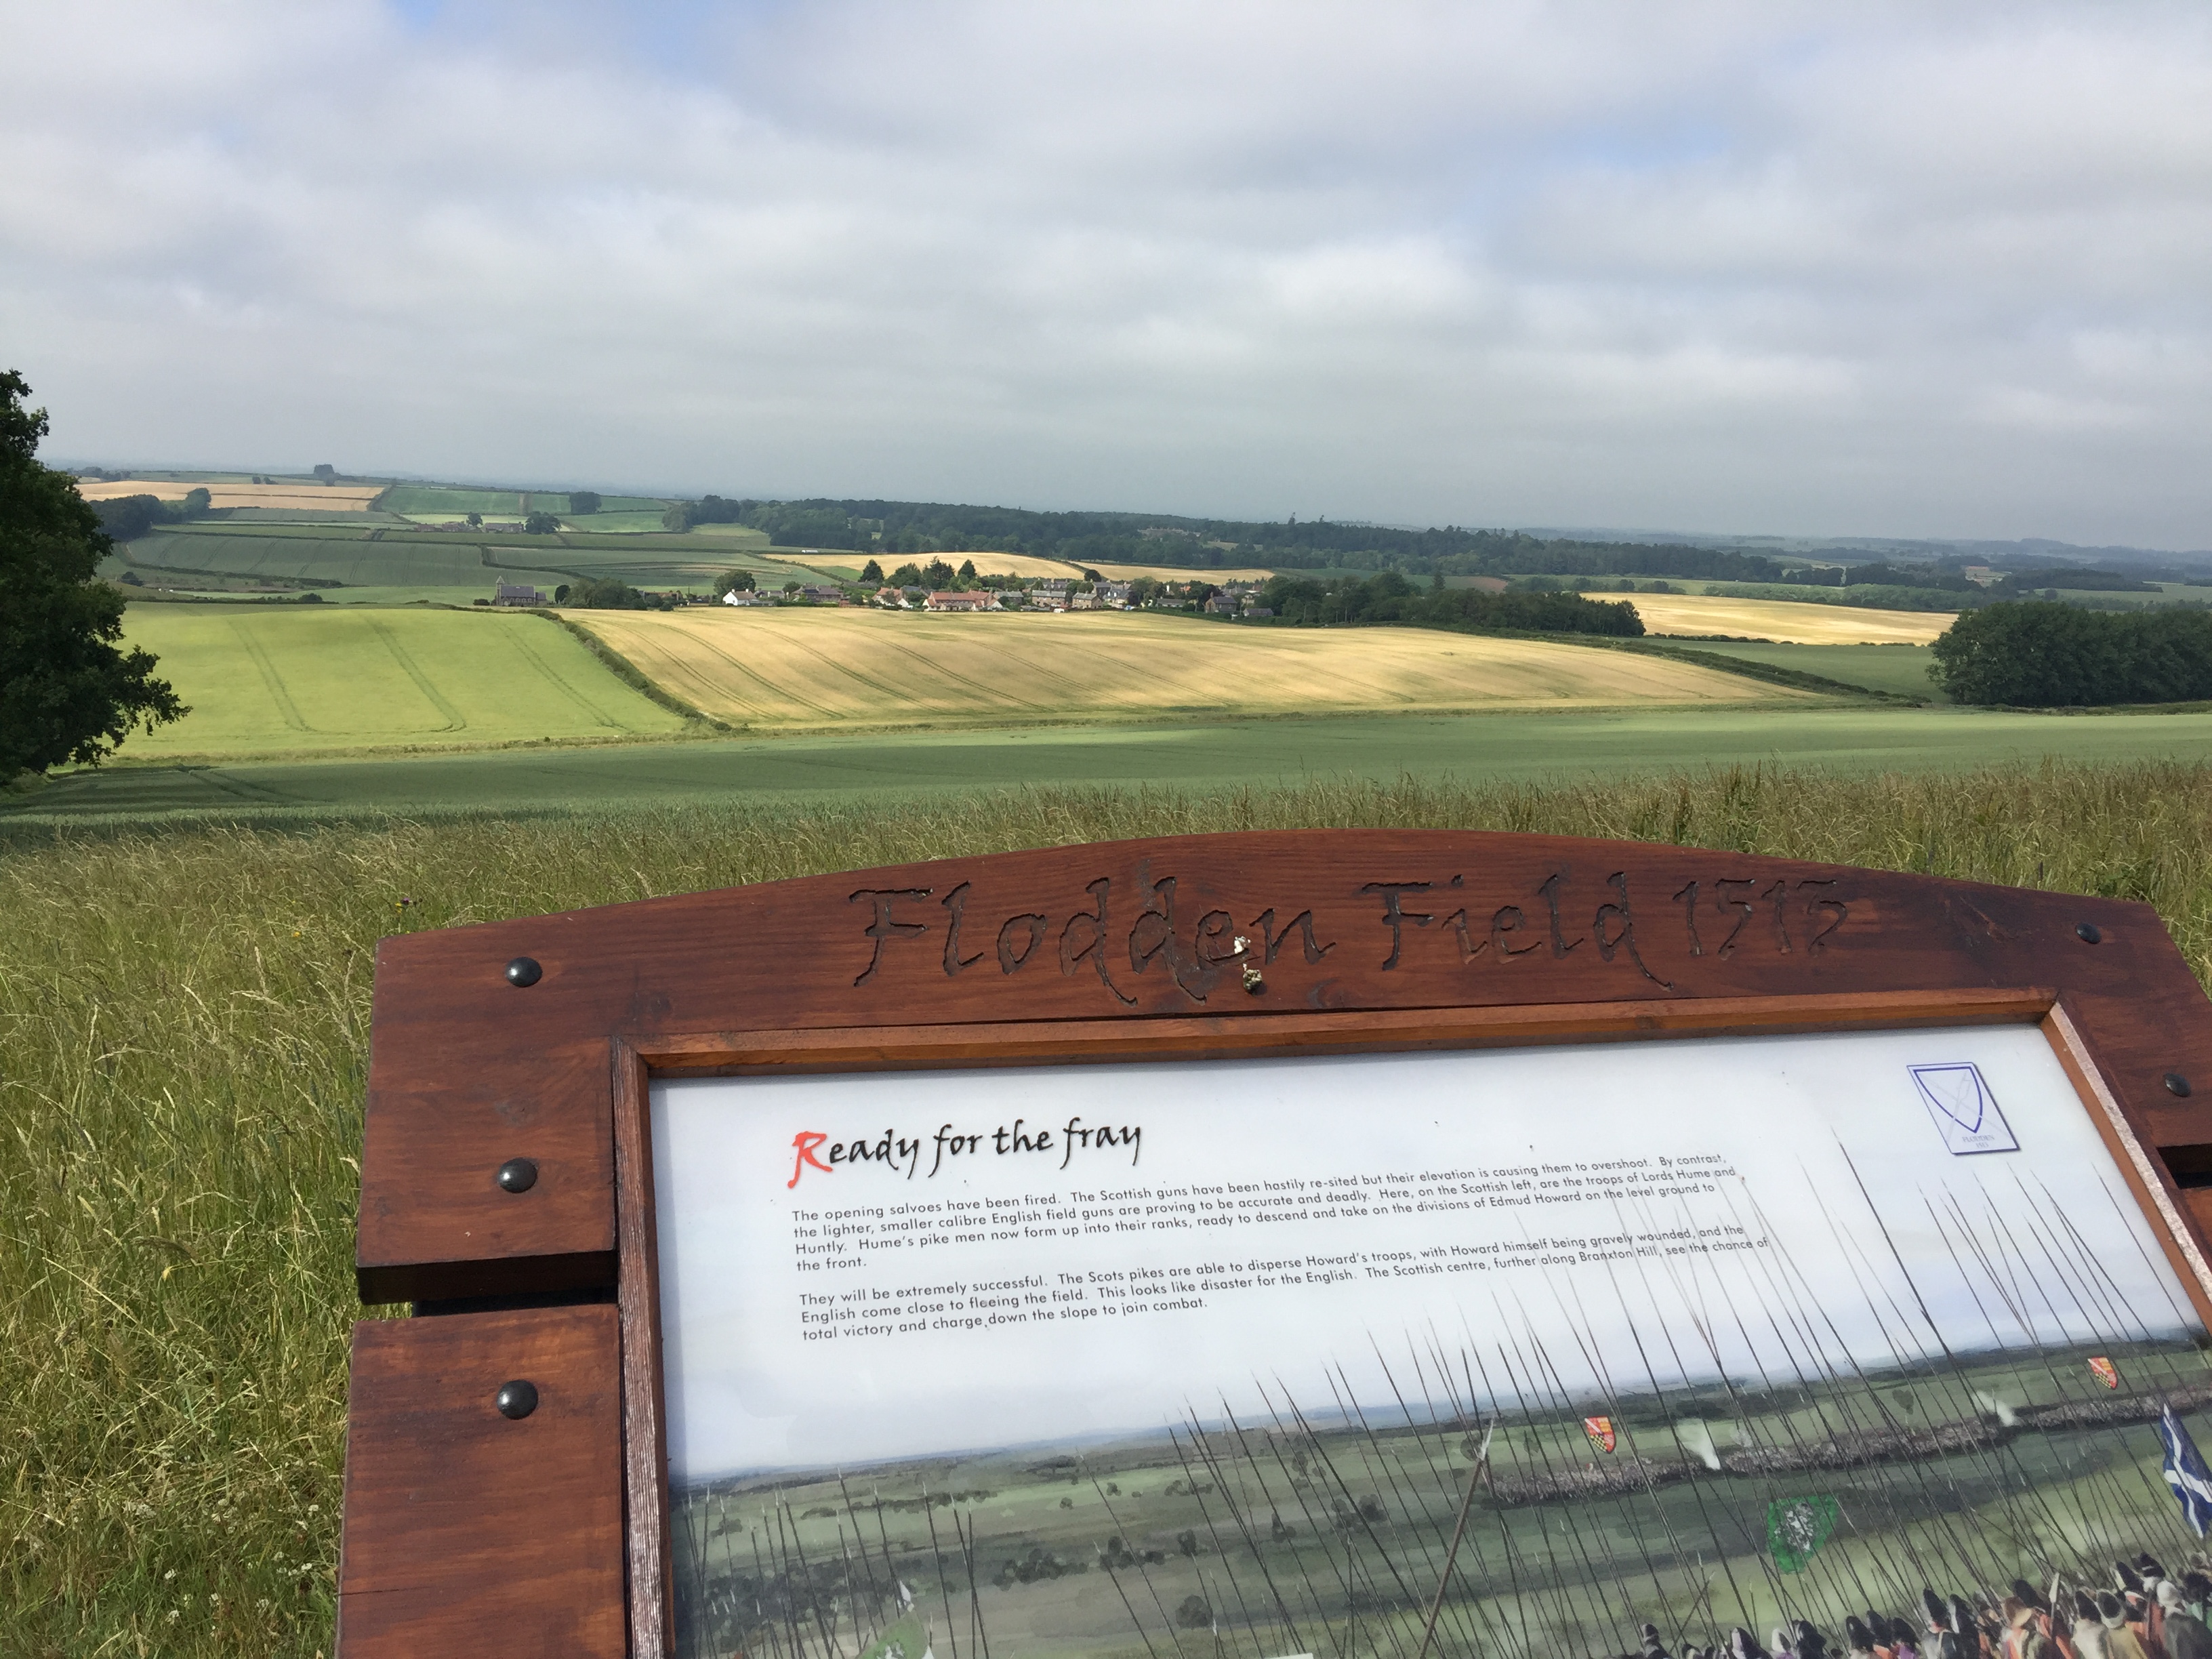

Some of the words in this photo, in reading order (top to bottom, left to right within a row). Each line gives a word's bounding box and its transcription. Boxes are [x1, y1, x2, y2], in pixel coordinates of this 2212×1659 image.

[848, 876, 1336, 1006] Flodden
[1359, 870, 1675, 991] Field
[787, 1128, 920, 1189] Ready
[928, 1123, 983, 1179] for
[991, 1118, 1054, 1155] the
[1059, 1116, 1141, 1170] fray
[793, 1210, 819, 1221] The
[825, 1206, 884, 1221] opening
[890, 1203, 942, 1214] salvoes
[947, 1200, 981, 1210] have
[985, 1197, 1020, 1208] been
[1024, 1193, 1061, 1205] fired.
[1071, 1191, 1095, 1202] The
[1100, 1187, 1152, 1201] Scottish
[1156, 1189, 1188, 1200] guns
[1192, 1185, 1223, 1195] have
[1227, 1183, 1260, 1193] been
[1264, 1179, 1305, 1191] hastily
[1309, 1175, 1358, 1187] re-sited
[1361, 1174, 1382, 1185] but
[1386, 1172, 1414, 1183] their
[1419, 1169, 1475, 1181] elevation
[1479, 1168, 1490, 1177] is
[1492, 1166, 1539, 1176] causing
[1541, 1164, 1572, 1173] them
[1575, 1163, 1588, 1171] to
[1659, 1157, 1673, 1168] By
[794, 1227, 817, 1237] the
[823, 1223, 874, 1237] lighter,
[880, 1218, 933, 1231] smaller
[938, 1215, 987, 1227] calibre
[991, 1210, 1042, 1225] English
[1046, 1208, 1077, 1220] field
[1082, 1209, 1114, 1221] guns
[1118, 1207, 1141, 1215] are
[1145, 1202, 1195, 1216] proving
[1200, 1201, 1213, 1210] to
[1217, 1199, 1233, 1209] be
[1238, 1196, 1293, 1208] accurate
[1297, 1193, 1322, 1204] and
[1326, 1190, 1371, 1202] deadly.
[1378, 1189, 1414, 1199] Here,
[1437, 1185, 1458, 1195] the
[1460, 1181, 1509, 1193] Scottish
[1511, 1179, 1536, 1191] left,
[1563, 1177, 1582, 1186] the
[1585, 1176, 1624, 1186] troops
[1626, 1172, 1639, 1183] of
[1641, 1170, 1674, 1181] Lords
[1676, 1170, 1711, 1179] Hume
[1714, 1166, 1736, 1176] and
[796, 1241, 847, 1254] Huntly.
[859, 1236, 914, 1250] Hume's
[920, 1233, 949, 1248] pike
[955, 1233, 985, 1242] men
[991, 1231, 1019, 1240] now
[1024, 1227, 1057, 1237] form
[1062, 1227, 1080, 1237] up
[1084, 1223, 1110, 1233] into
[1115, 1220, 1147, 1231] their
[1151, 1217, 1192, 1229] ranks,
[1197, 1214, 1233, 1227] ready
[1237, 1214, 1251, 1223] to
[1255, 1208, 1308, 1222] descend
[1312, 1207, 1337, 1218] and
[1340, 1206, 1368, 1216] take
[1392, 1203, 1412, 1213] the
[1416, 1200, 1470, 1212] divisions
[1473, 1197, 1486, 1208] of
[1489, 1194, 1532, 1206] Edmud
[1534, 1191, 1582, 1204] Howard
[1603, 1189, 1624, 1200] the
[1626, 1186, 1655, 1197] level
[1658, 1183, 1700, 1197] ground
[796, 1260, 820, 1271] the
[825, 1257, 867, 1269] front.
[800, 1293, 835, 1306] They
[840, 1289, 866, 1301] will
[872, 1288, 890, 1299] be
[896, 1282, 967, 1297] extremely
[972, 1275, 1048, 1291] successful.
[1059, 1273, 1083, 1284] The
[1088, 1271, 1124, 1282] Scots
[1129, 1267, 1164, 1282] pikes
[1169, 1268, 1191, 1276] are
[1196, 1263, 1225, 1274] able
[1229, 1263, 1243, 1271] to
[1248, 1260, 1302, 1272] disperse
[1306, 1252, 1368, 1266] Howard's
[1371, 1252, 1416, 1263] troops,
[1419, 1246, 1448, 1257] with
[1450, 1242, 1500, 1255] Howard
[1502, 1238, 1548, 1252] himself
[1551, 1237, 1587, 1248] being
[1590, 1231, 1633, 1248] gravely
[1698, 1226, 1721, 1238] and
[1723, 1225, 1746, 1235] the
[801, 1307, 856, 1324] English
[861, 1307, 901, 1317] come
[907, 1302, 944, 1314] close
[949, 1300, 964, 1310] to
[969, 1296, 1019, 1309] fleeing
[1024, 1292, 1047, 1304] the
[1052, 1288, 1088, 1302] field.
[1099, 1286, 1126, 1298] This
[1130, 1283, 1167, 1296] looks
[1171, 1281, 1196, 1292] like
[1200, 1279, 1253, 1290] disaster
[1256, 1275, 1276, 1286] for
[1280, 1273, 1302, 1284] the
[1366, 1267, 1389, 1277] The
[1393, 1263, 1443, 1276] Scottish
[1447, 1261, 1491, 1272] centre,
[1494, 1256, 1536, 1268] further
[1540, 1254, 1576, 1265] along
[1578, 1250, 1636, 1261] Branxton
[1664, 1247, 1686, 1255] see
[1689, 1240, 1708, 1252] the
[1712, 1240, 1754, 1251] chance
[1757, 1235, 1771, 1247] of
[802, 1326, 838, 1340] total
[843, 1325, 893, 1336] victory
[899, 1318, 926, 1332] and
[988, 1313, 1027, 1324] down
[1031, 1309, 1055, 1320] the
[1060, 1307, 1097, 1319] slope
[1102, 1305, 1117, 1315] to
[1122, 1302, 1148, 1316] join
[1153, 1298, 1208, 1311] combat.
